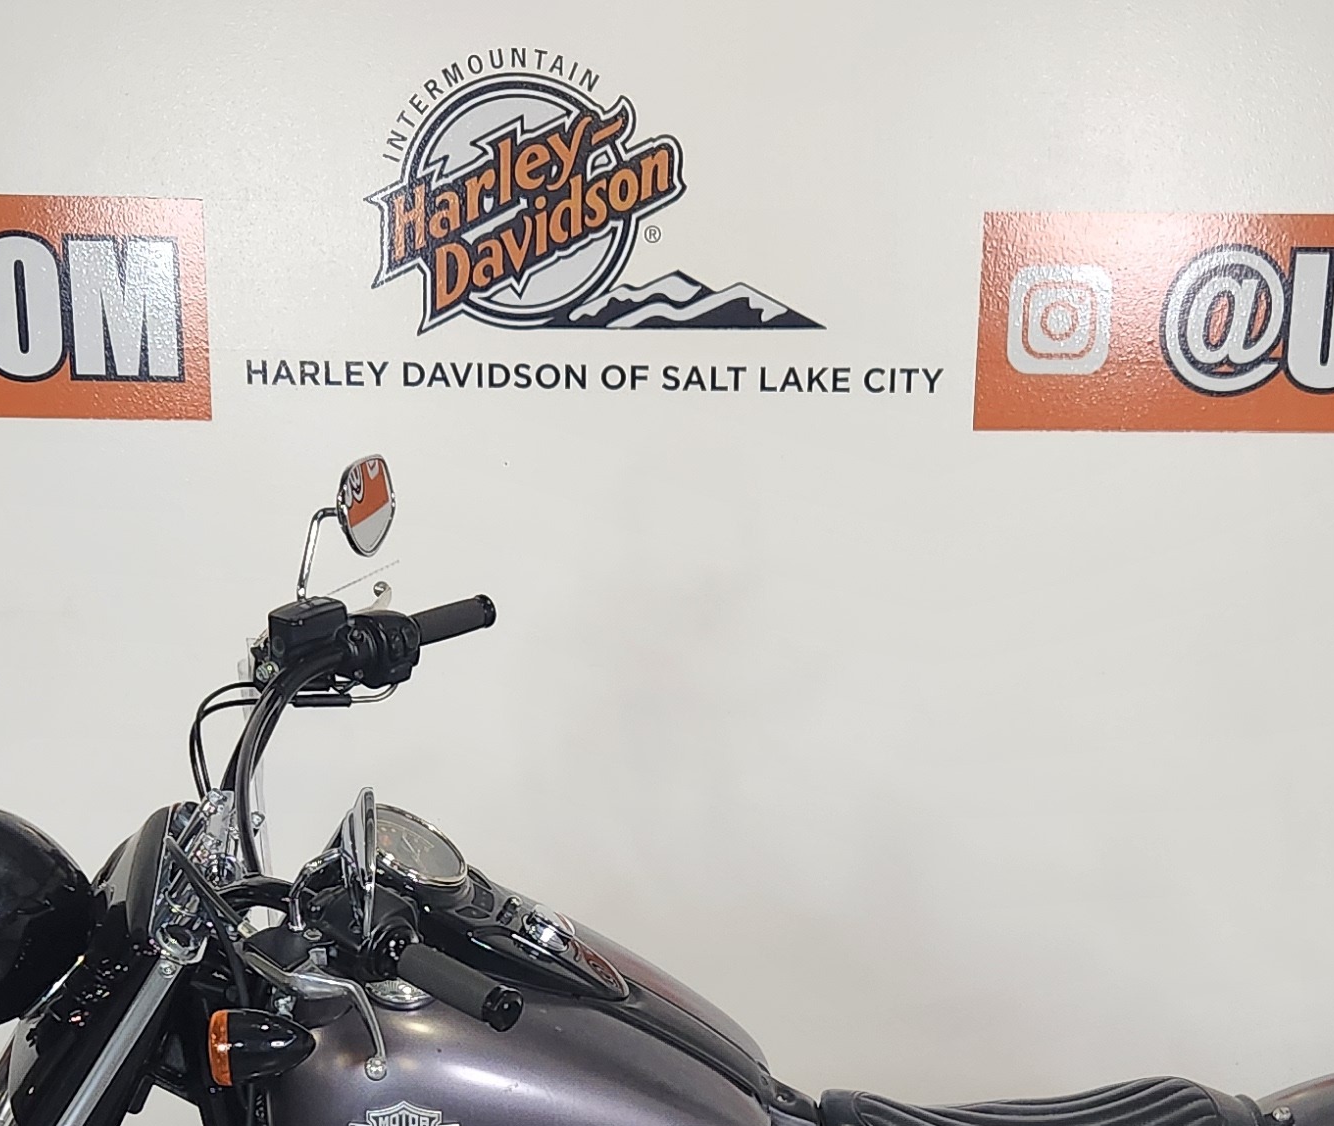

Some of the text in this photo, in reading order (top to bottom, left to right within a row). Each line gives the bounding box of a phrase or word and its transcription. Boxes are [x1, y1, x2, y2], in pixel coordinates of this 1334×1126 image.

[382, 47, 600, 163] INTERMOUNTAIN
[435, 149, 669, 310] Davidson
[245, 359, 945, 394] HARLEY DAVIDSON OF SALT LAKE CITY
